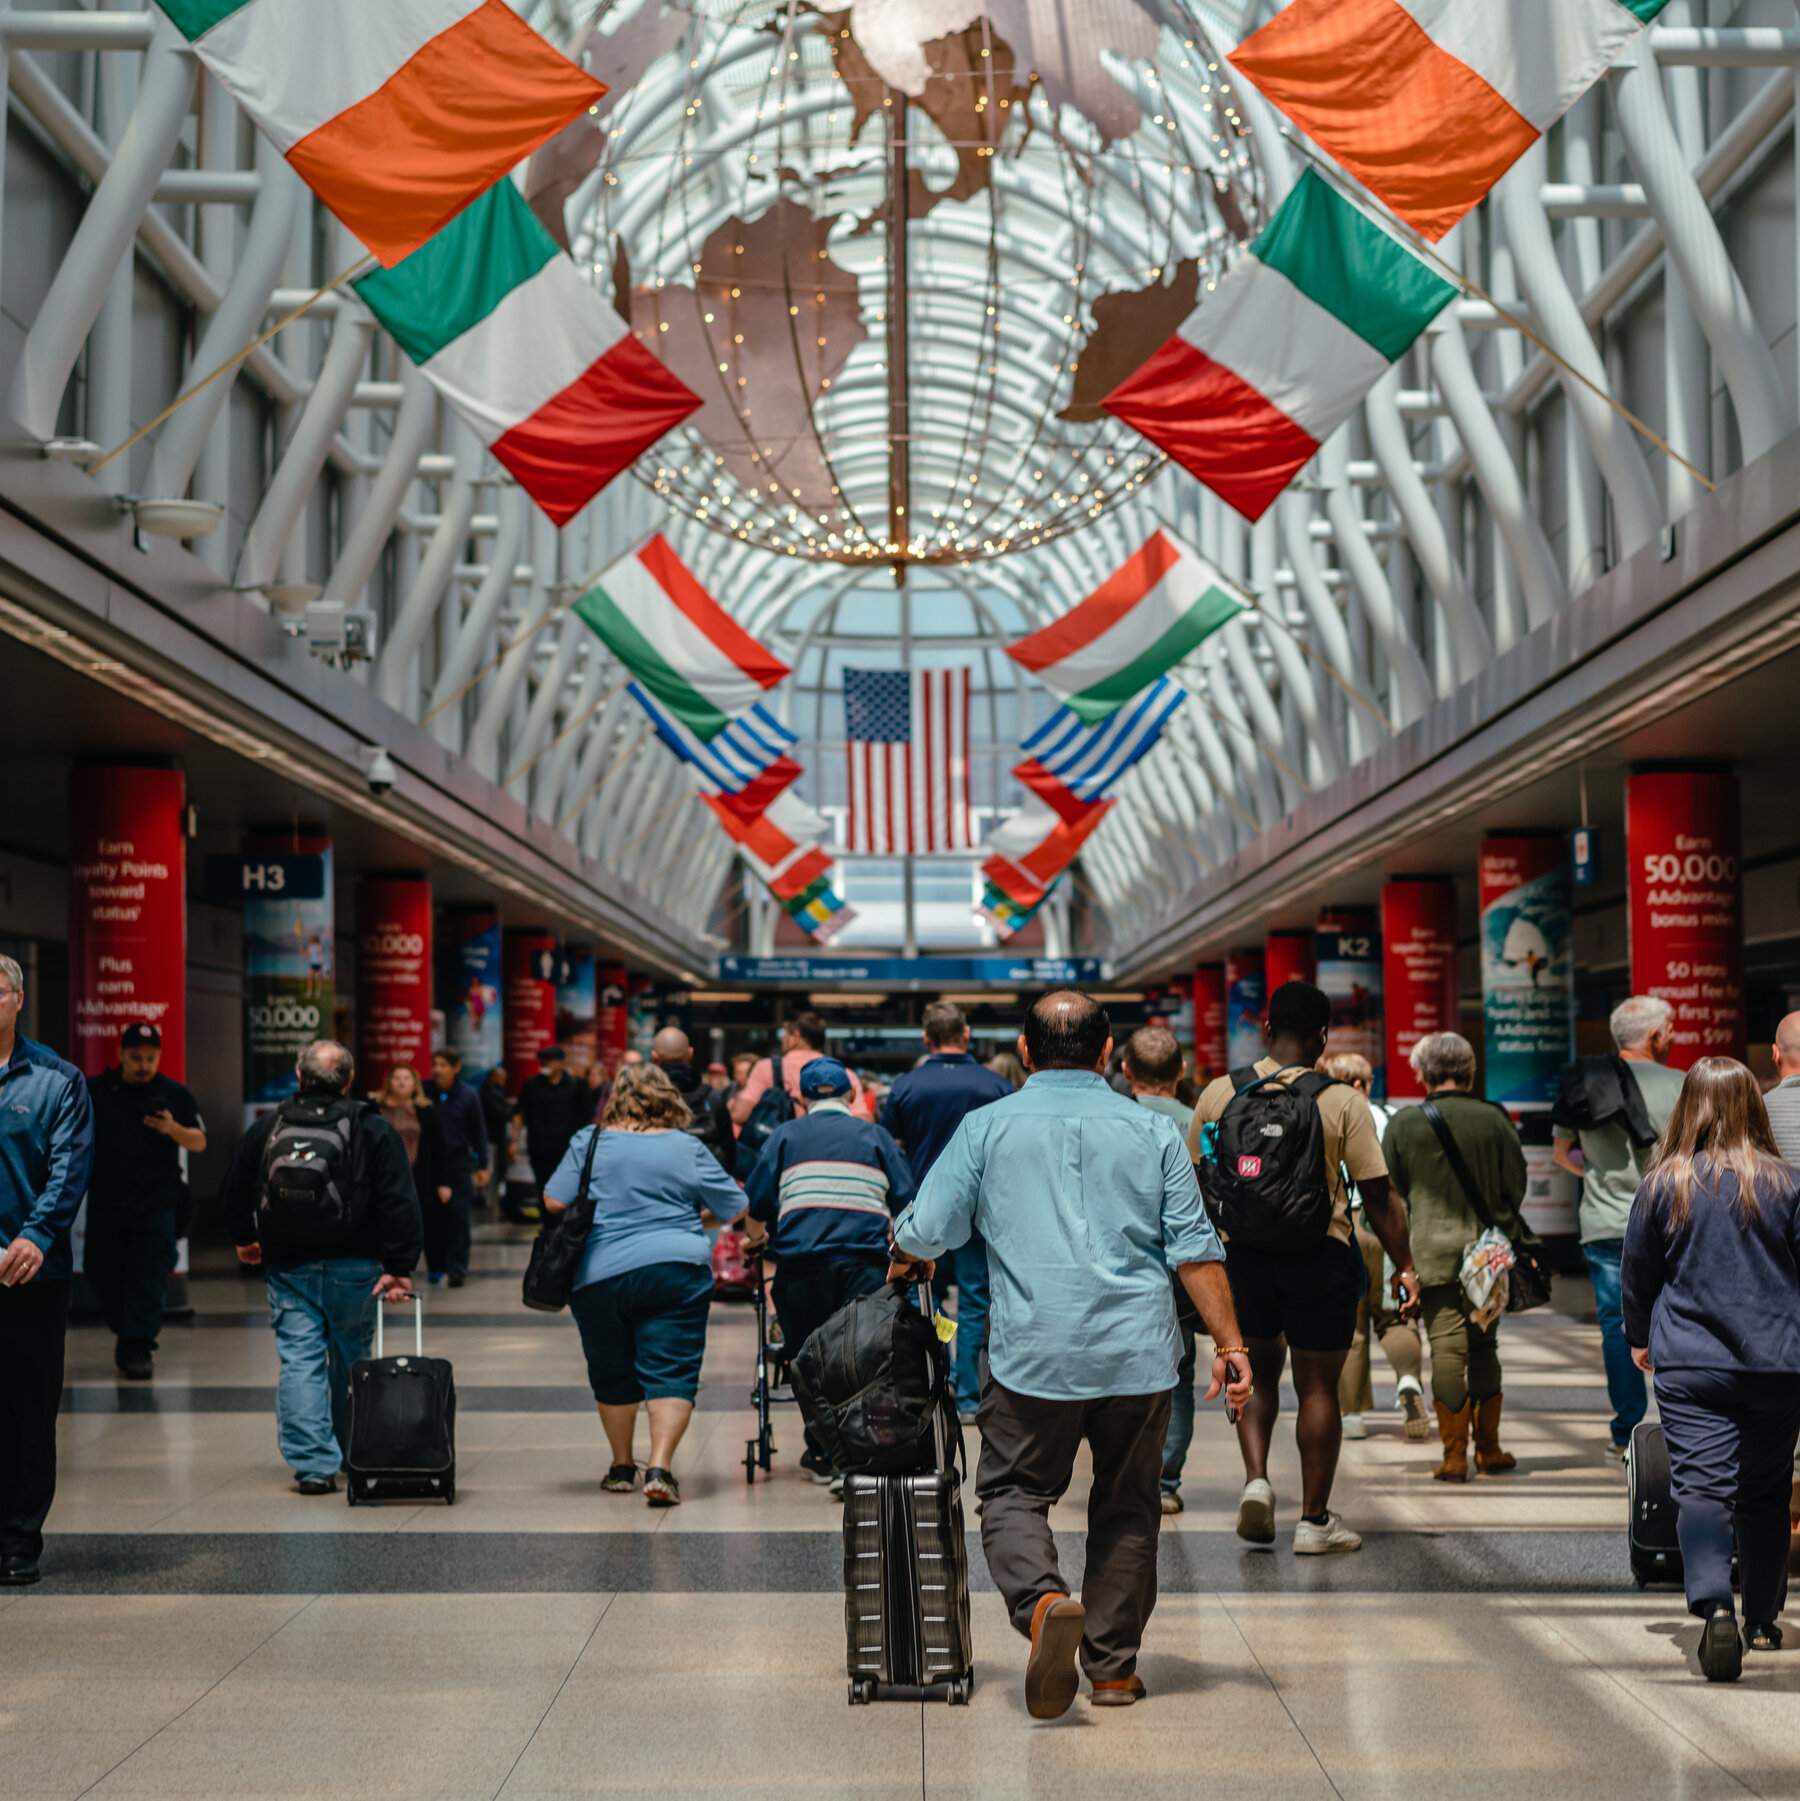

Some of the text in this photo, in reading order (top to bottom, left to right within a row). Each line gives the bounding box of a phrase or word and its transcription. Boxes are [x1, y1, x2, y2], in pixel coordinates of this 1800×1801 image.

[98, 841, 134, 856] Earn
[1675, 834, 1711, 851] Earn
[121, 860, 168, 879] Points
[243, 864, 285, 890] H3
[1644, 854, 1737, 886] 50,000
[89, 882, 145, 899] toward
[1650, 910, 1699, 928] bonus
[1338, 937, 1370, 957] K2
[99, 957, 133, 973] Plus
[1666, 960, 1727, 980] $0 intro
[97, 981, 134, 994] earn
[1648, 983, 1699, 999] annual
[1701, 982, 1724, 998] fee
[1678, 1003, 1711, 1020] first
